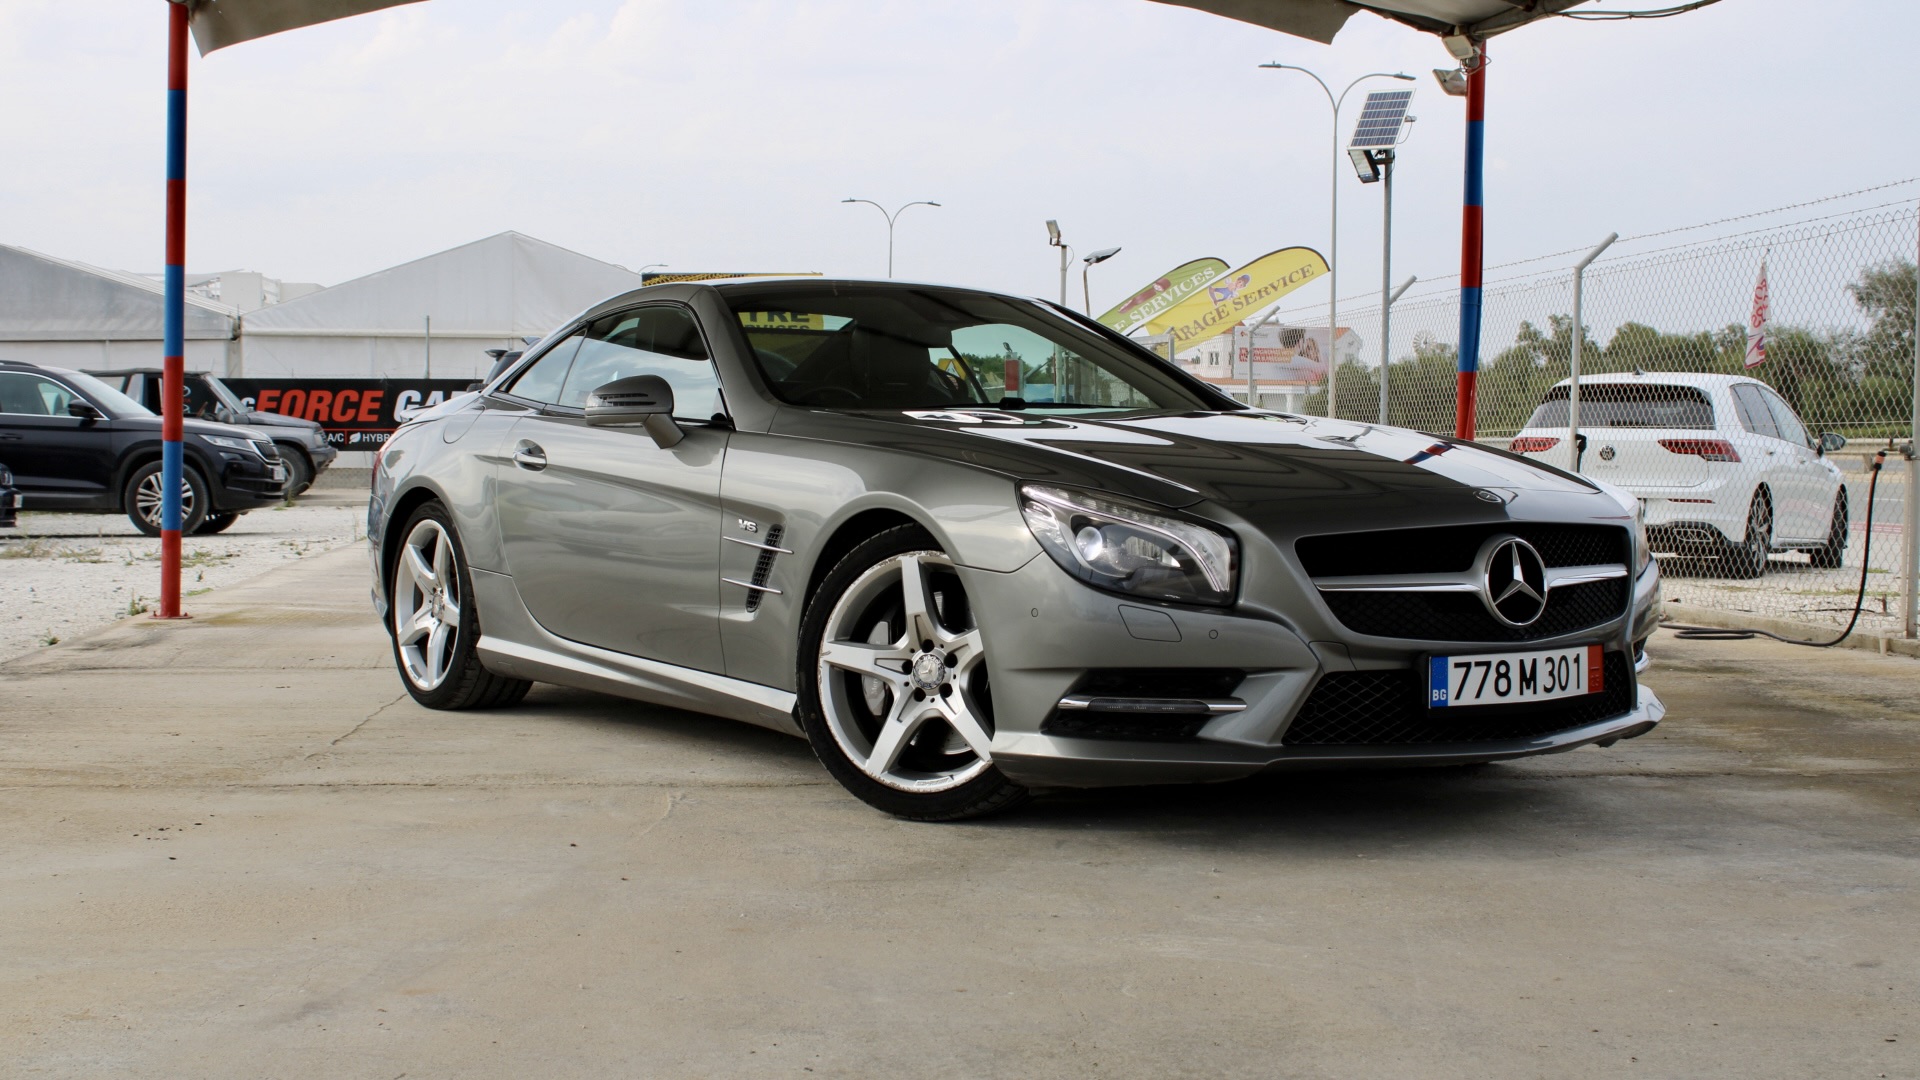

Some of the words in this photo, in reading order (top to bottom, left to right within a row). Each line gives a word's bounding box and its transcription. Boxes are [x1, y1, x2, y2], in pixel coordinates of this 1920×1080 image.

[1130, 267, 1215, 323] SERVICES
[1233, 263, 1315, 311] SERVICE
[327, 433, 345, 442] A/C
[362, 433, 392, 442] HYBR
[1432, 689, 1447, 701] BG
[1453, 659, 1512, 700] 778
[1519, 658, 1537, 696] M
[1543, 653, 1581, 693] 301
